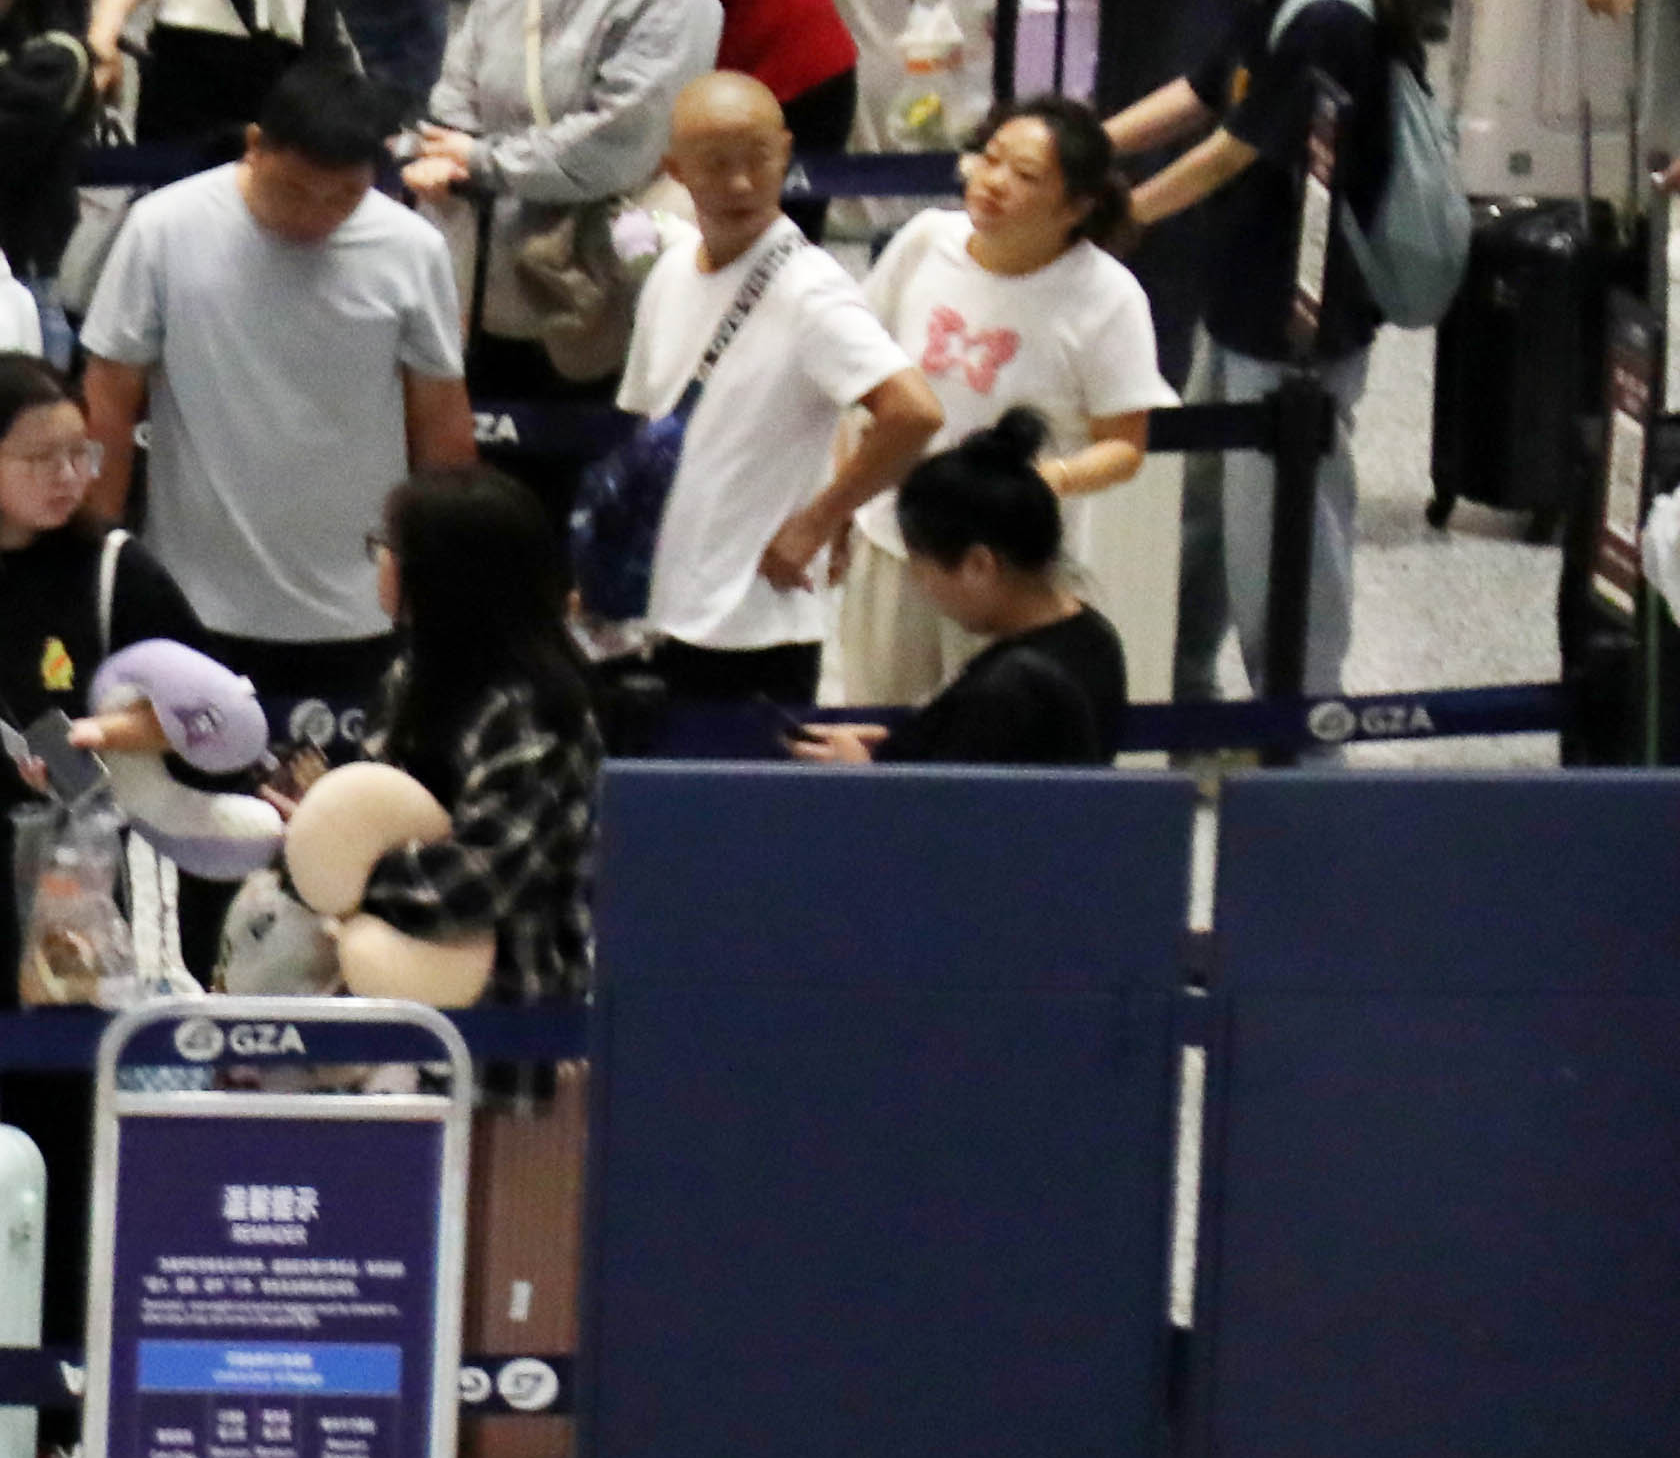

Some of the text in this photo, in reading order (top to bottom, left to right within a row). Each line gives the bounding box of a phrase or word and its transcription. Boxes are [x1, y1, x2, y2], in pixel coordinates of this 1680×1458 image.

[474, 412, 518, 442] ZA
[1361, 707, 1434, 732] GZA
[228, 1022, 307, 1055] GZA
